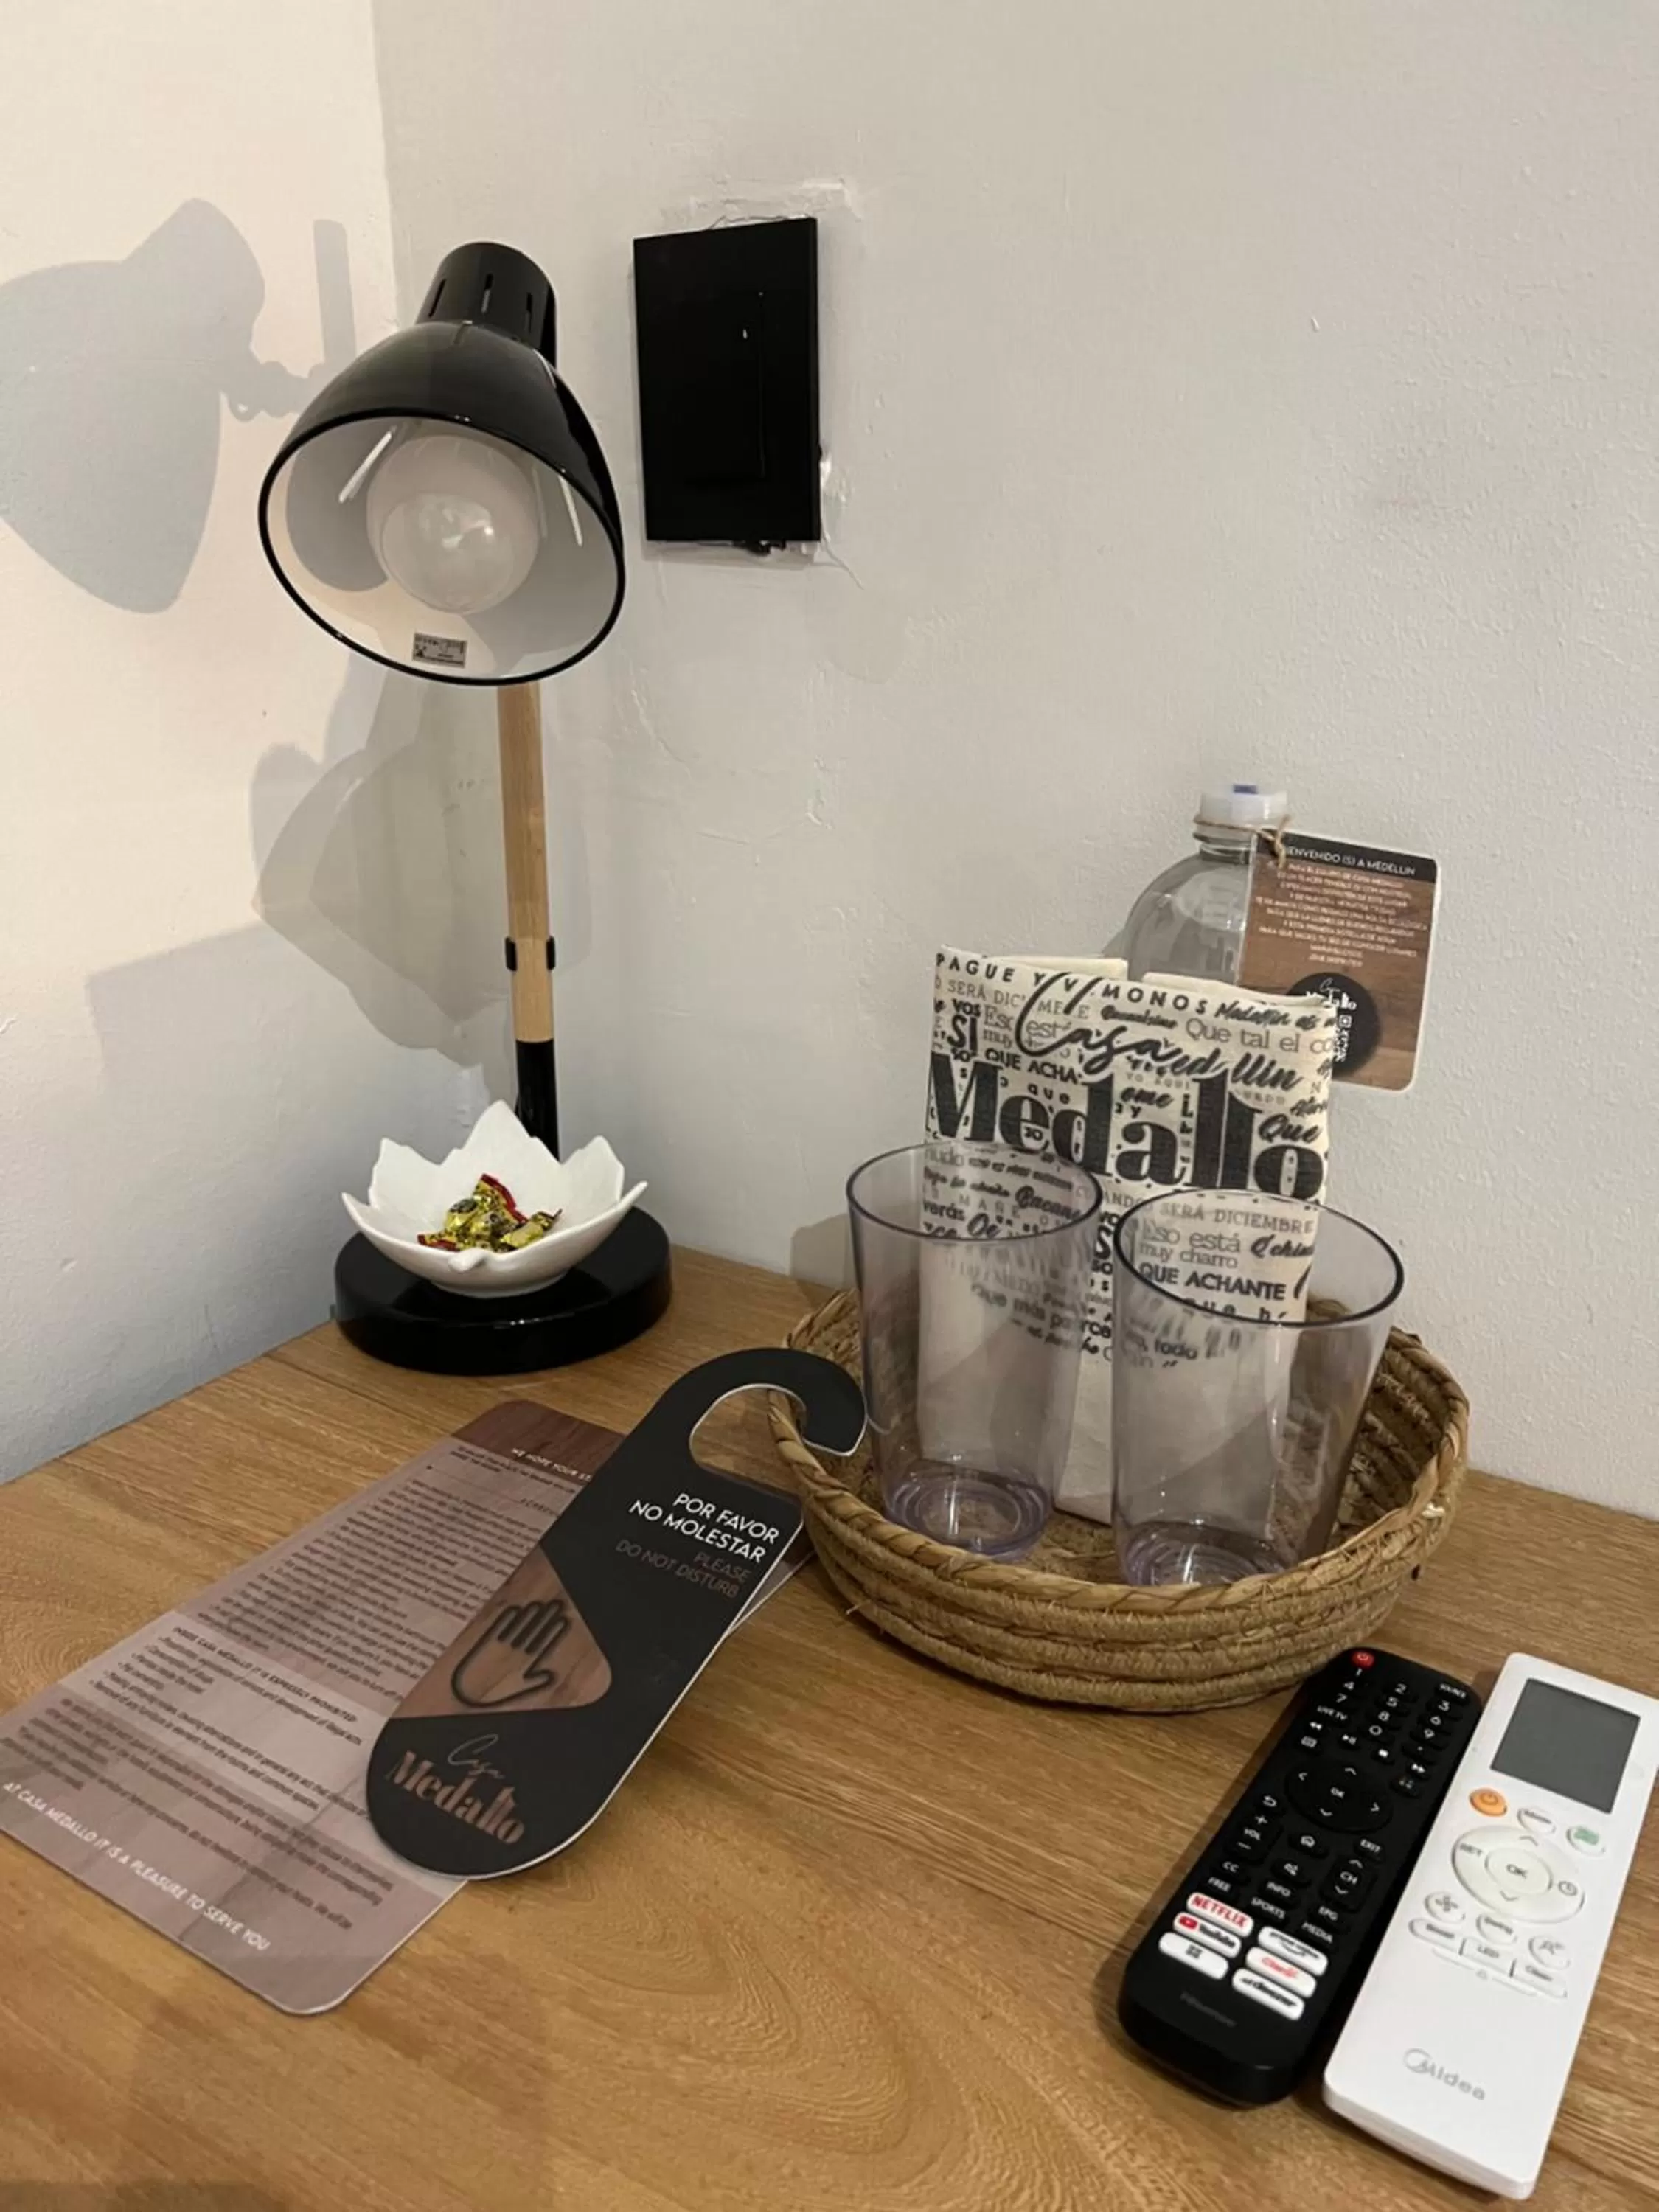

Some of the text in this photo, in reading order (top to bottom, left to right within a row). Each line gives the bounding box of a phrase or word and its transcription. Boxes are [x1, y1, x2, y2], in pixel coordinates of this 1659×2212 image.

[935, 952, 1015, 983] PAGUE
[1063, 978, 1208, 1015] VMONOS
[1185, 1018, 1232, 1043] Que
[1240, 1029, 1270, 1049] tal
[1279, 1033, 1301, 1053] el
[984, 1047, 1023, 1070] QUE
[926, 1050, 1324, 1201] Medallo
[1257, 1113, 1323, 1144] Que
[1214, 1208, 1316, 1234] DICIEMBRE
[1189, 1232, 1241, 1253] está
[1138, 1262, 1287, 1302] QUE ACHANTE
[672, 1492, 779, 1545] POR FAVOR
[628, 1499, 766, 1563] NO MOLESTAR
[616, 1539, 738, 1599] DO NOT DISTURB
[693, 1551, 751, 1584] PLEASE
[1335, 1693, 1348, 1703] 7
[1394, 1683, 1407, 1694] 2
[1386, 1697, 1398, 1707] 5
[1439, 1700, 1450, 1711] 3
[1378, 1710, 1390, 1721] 8
[384, 1749, 526, 1844] Medallo
[1244, 1828, 1261, 1841] VOL
[1360, 1839, 1381, 1853] EXIT
[18, 1789, 48, 1812] CASA
[44, 1806, 97, 1843] MEDALLO
[130, 1860, 189, 1900] PLEASURE
[185, 1893, 206, 1910] TO
[203, 1905, 245, 1935] SERVE
[242, 1928, 272, 1951] YOU
[1222, 1861, 1239, 1873] CC
[1340, 1871, 1359, 1885] CH
[1208, 1877, 1231, 1893] FREE
[1267, 1882, 1291, 1897] INFO
[1191, 1895, 1247, 1929] NETFLIX
[1251, 1897, 1286, 1919] SPORTS
[1301, 1921, 1333, 1944] MEDIA
